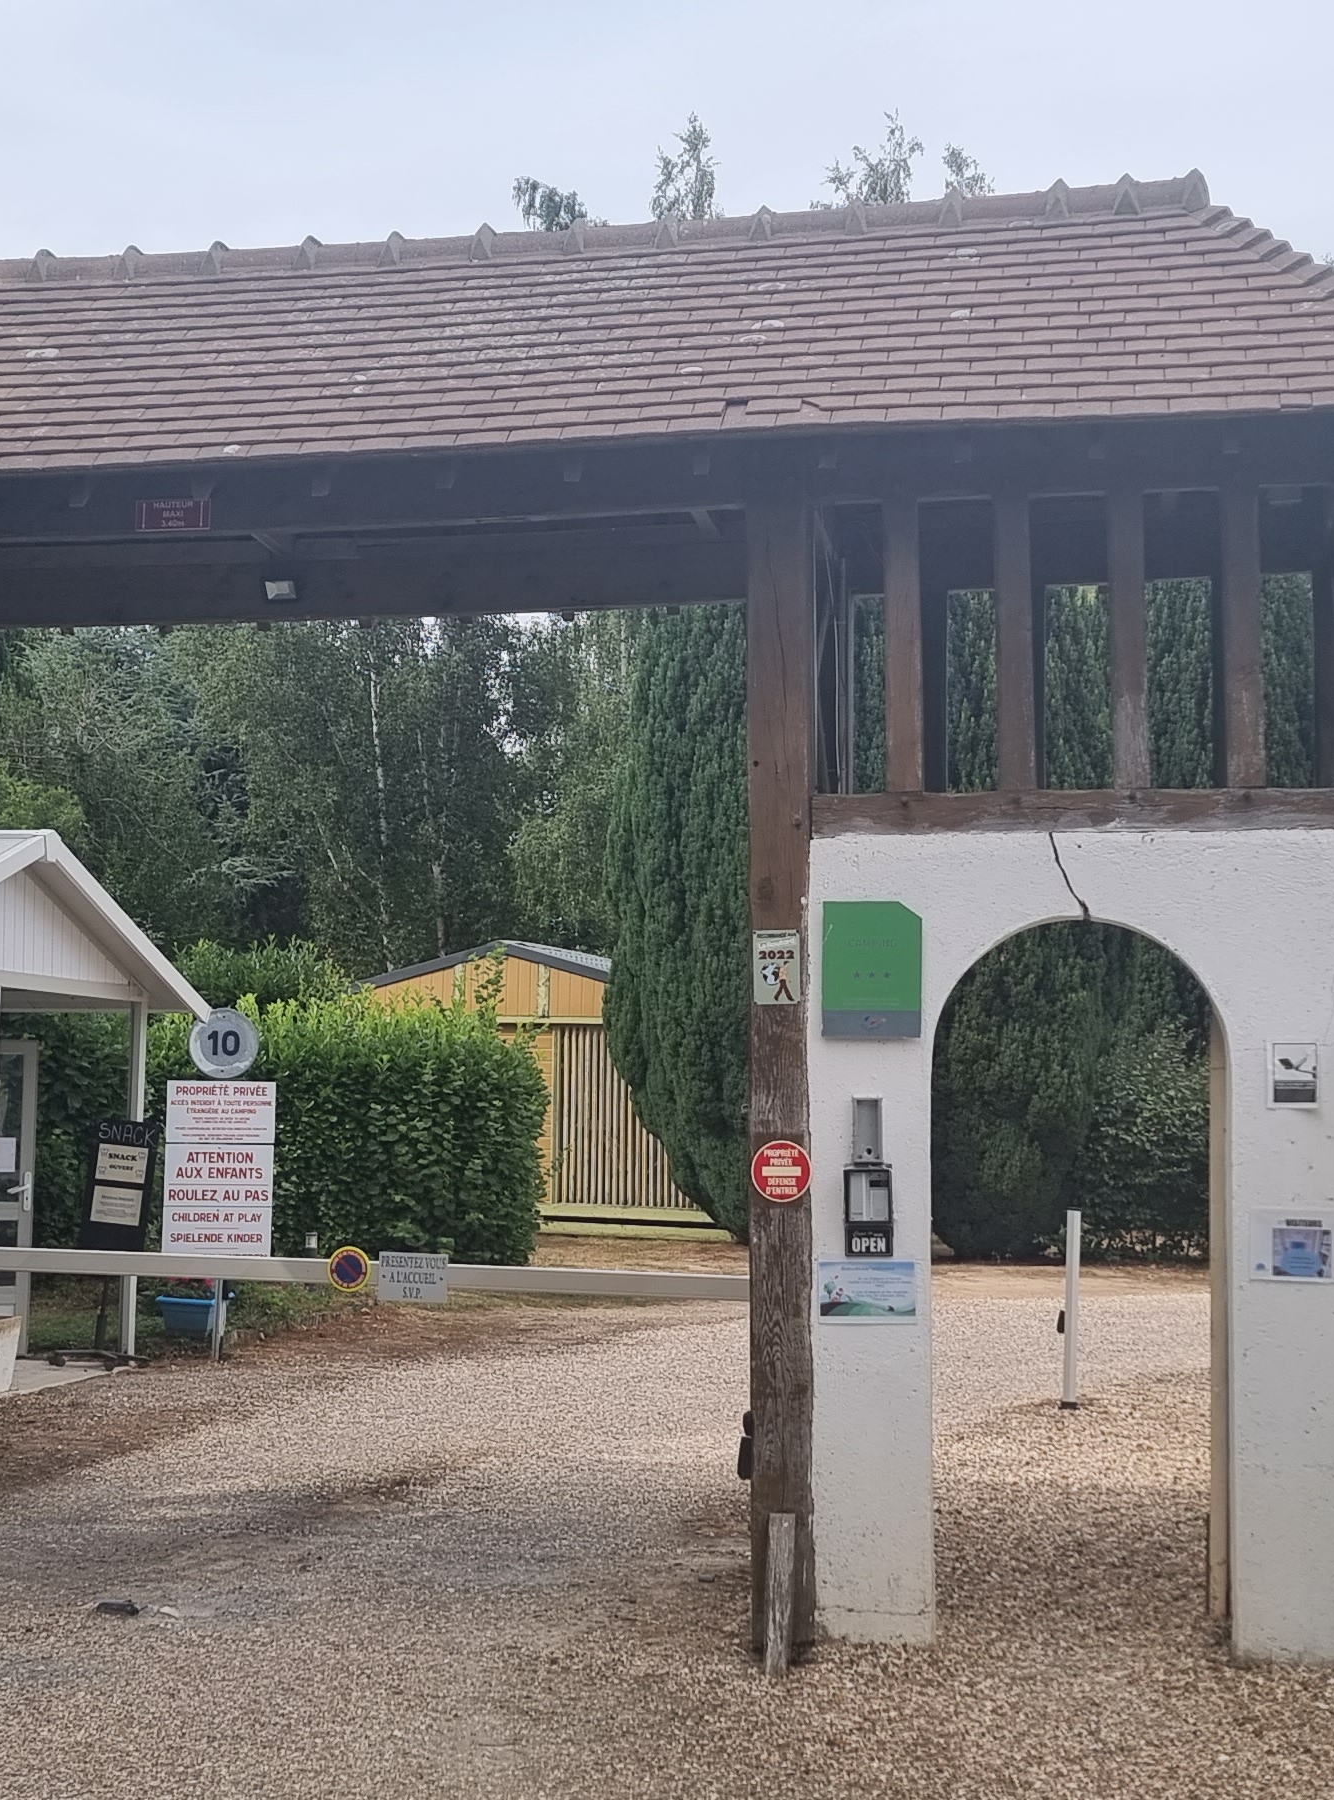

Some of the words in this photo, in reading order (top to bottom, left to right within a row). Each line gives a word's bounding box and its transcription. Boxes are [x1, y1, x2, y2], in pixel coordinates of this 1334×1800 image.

[153, 501, 194, 509] HAUTEUR
[162, 510, 184, 518] MAXI
[758, 949, 795, 960] 2022
[208, 1030, 240, 1056] 10
[175, 1084, 229, 1096] PROPRIÉTÉ
[233, 1085, 268, 1096] PRIVÉE
[98, 1122, 157, 1147] SNACK
[108, 1152, 137, 1162] SNACK
[186, 1151, 254, 1164] ATTENTION
[763, 1147, 799, 1157] PROPRIÉTÉ
[769, 1157, 793, 1166] PRIVÉE
[175, 1166, 203, 1179] AUX
[207, 1167, 263, 1179] ENFANTS
[767, 1176, 797, 1186] DÉFENSE
[168, 1189, 218, 1201] ROULEZ
[222, 1189, 240, 1201] AU
[244, 1189, 269, 1202] PAS
[171, 1212, 220, 1222] CHILDREN
[222, 1212, 234, 1222] AT
[237, 1213, 262, 1223] PLAY
[170, 1233, 224, 1243] SPIELENDE
[227, 1233, 263, 1243] KINDER
[851, 1237, 886, 1253] OPEN
[380, 1255, 423, 1268] PRESENTEZ
[424, 1256, 447, 1269] VOUS
[389, 1271, 395, 1283] A
[396, 1271, 437, 1285] L'ACCUEIL
[402, 1286, 423, 1299] S.V.P.
